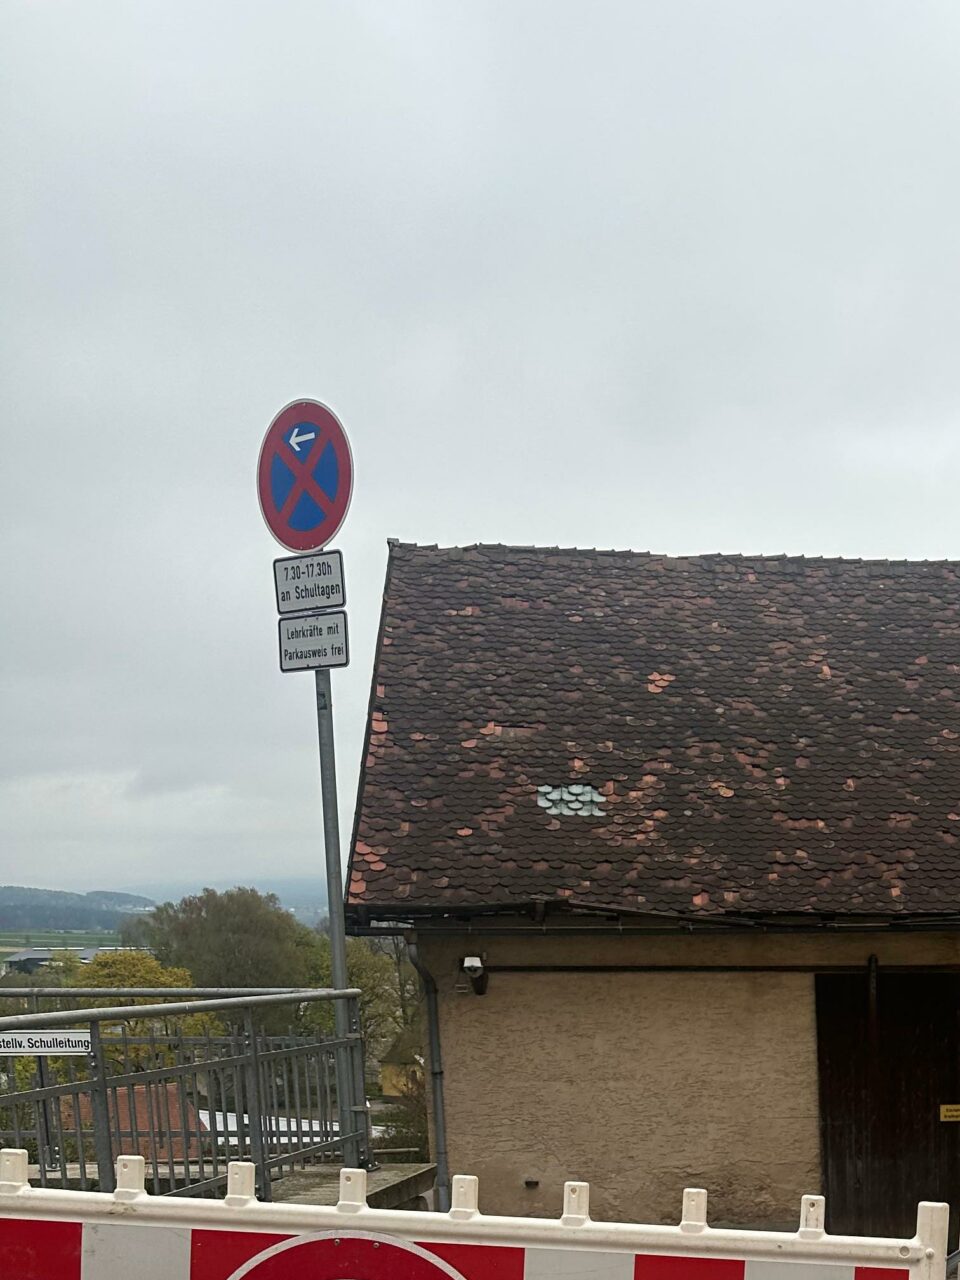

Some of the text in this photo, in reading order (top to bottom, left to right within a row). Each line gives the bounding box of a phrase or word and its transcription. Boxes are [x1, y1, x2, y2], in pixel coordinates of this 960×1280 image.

[284, 562, 332, 581] 7.30-17.30h
[281, 583, 340, 602] an Schultagen
[287, 622, 339, 640] Lehrkräfte mit
[284, 642, 344, 661] Parkausweis frei
[27, 1037, 90, 1050] Schulleitung
